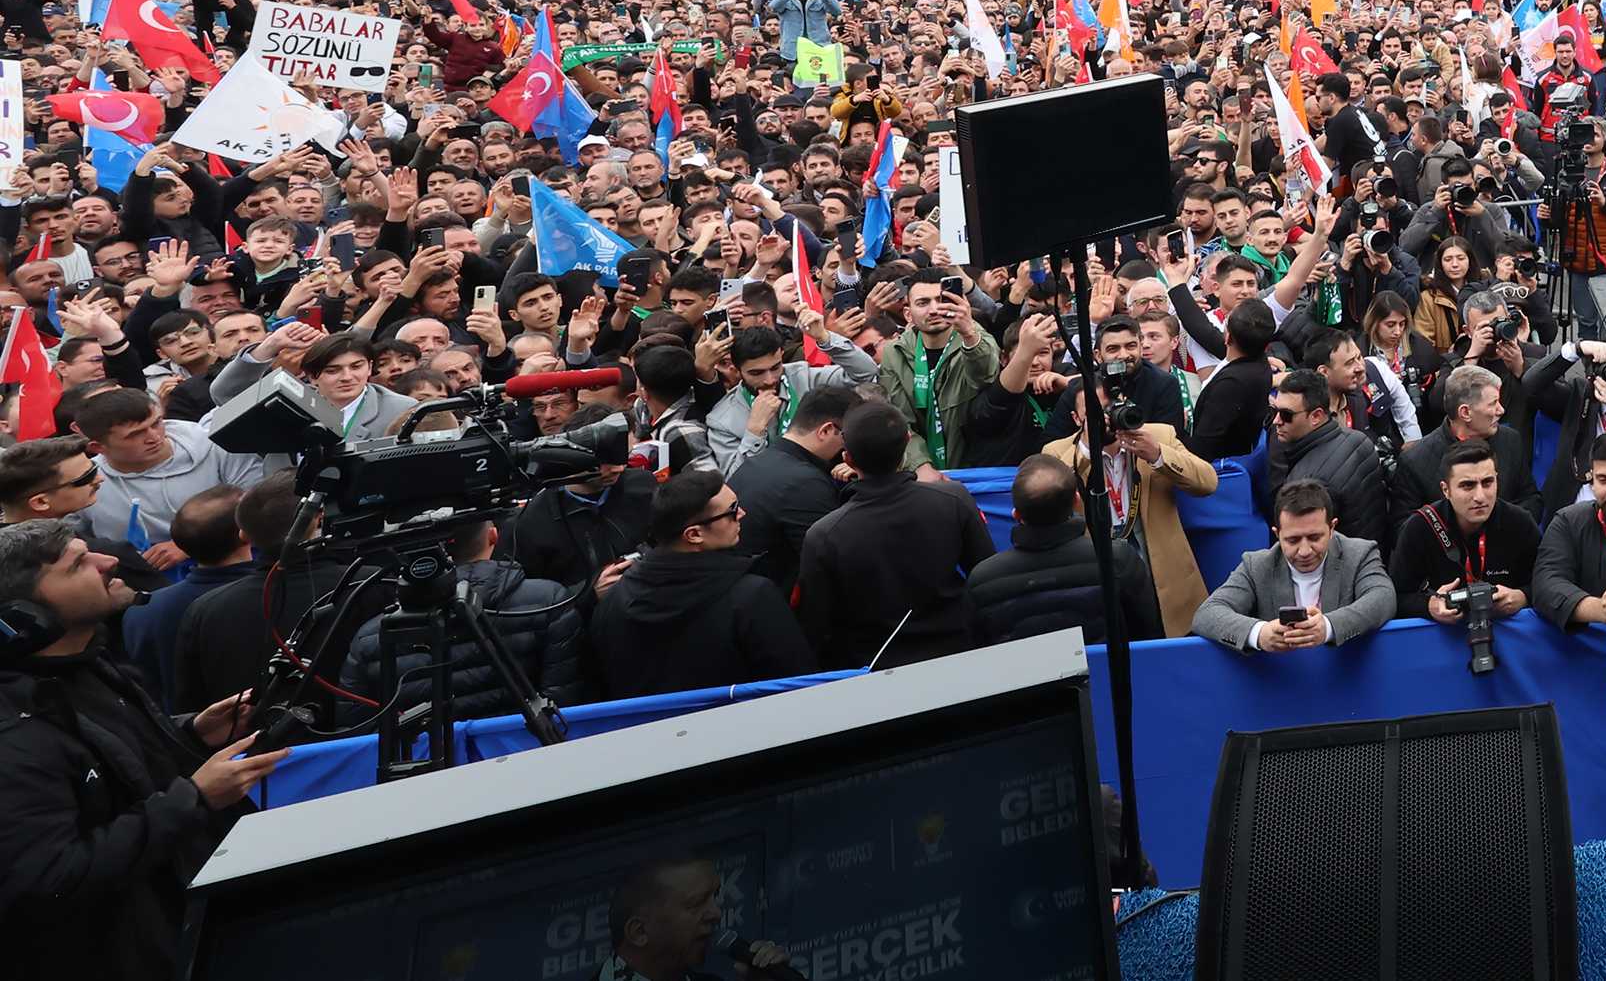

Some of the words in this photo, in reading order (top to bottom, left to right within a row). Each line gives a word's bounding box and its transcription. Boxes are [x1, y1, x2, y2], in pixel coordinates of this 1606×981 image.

[270, 7, 385, 40] BABALAR
[261, 31, 362, 62] SÖZÜNÜ
[261, 55, 337, 81] TUTAR
[217, 138, 248, 152] AK
[573, 261, 592, 272] AK
[476, 458, 488, 472] 2
